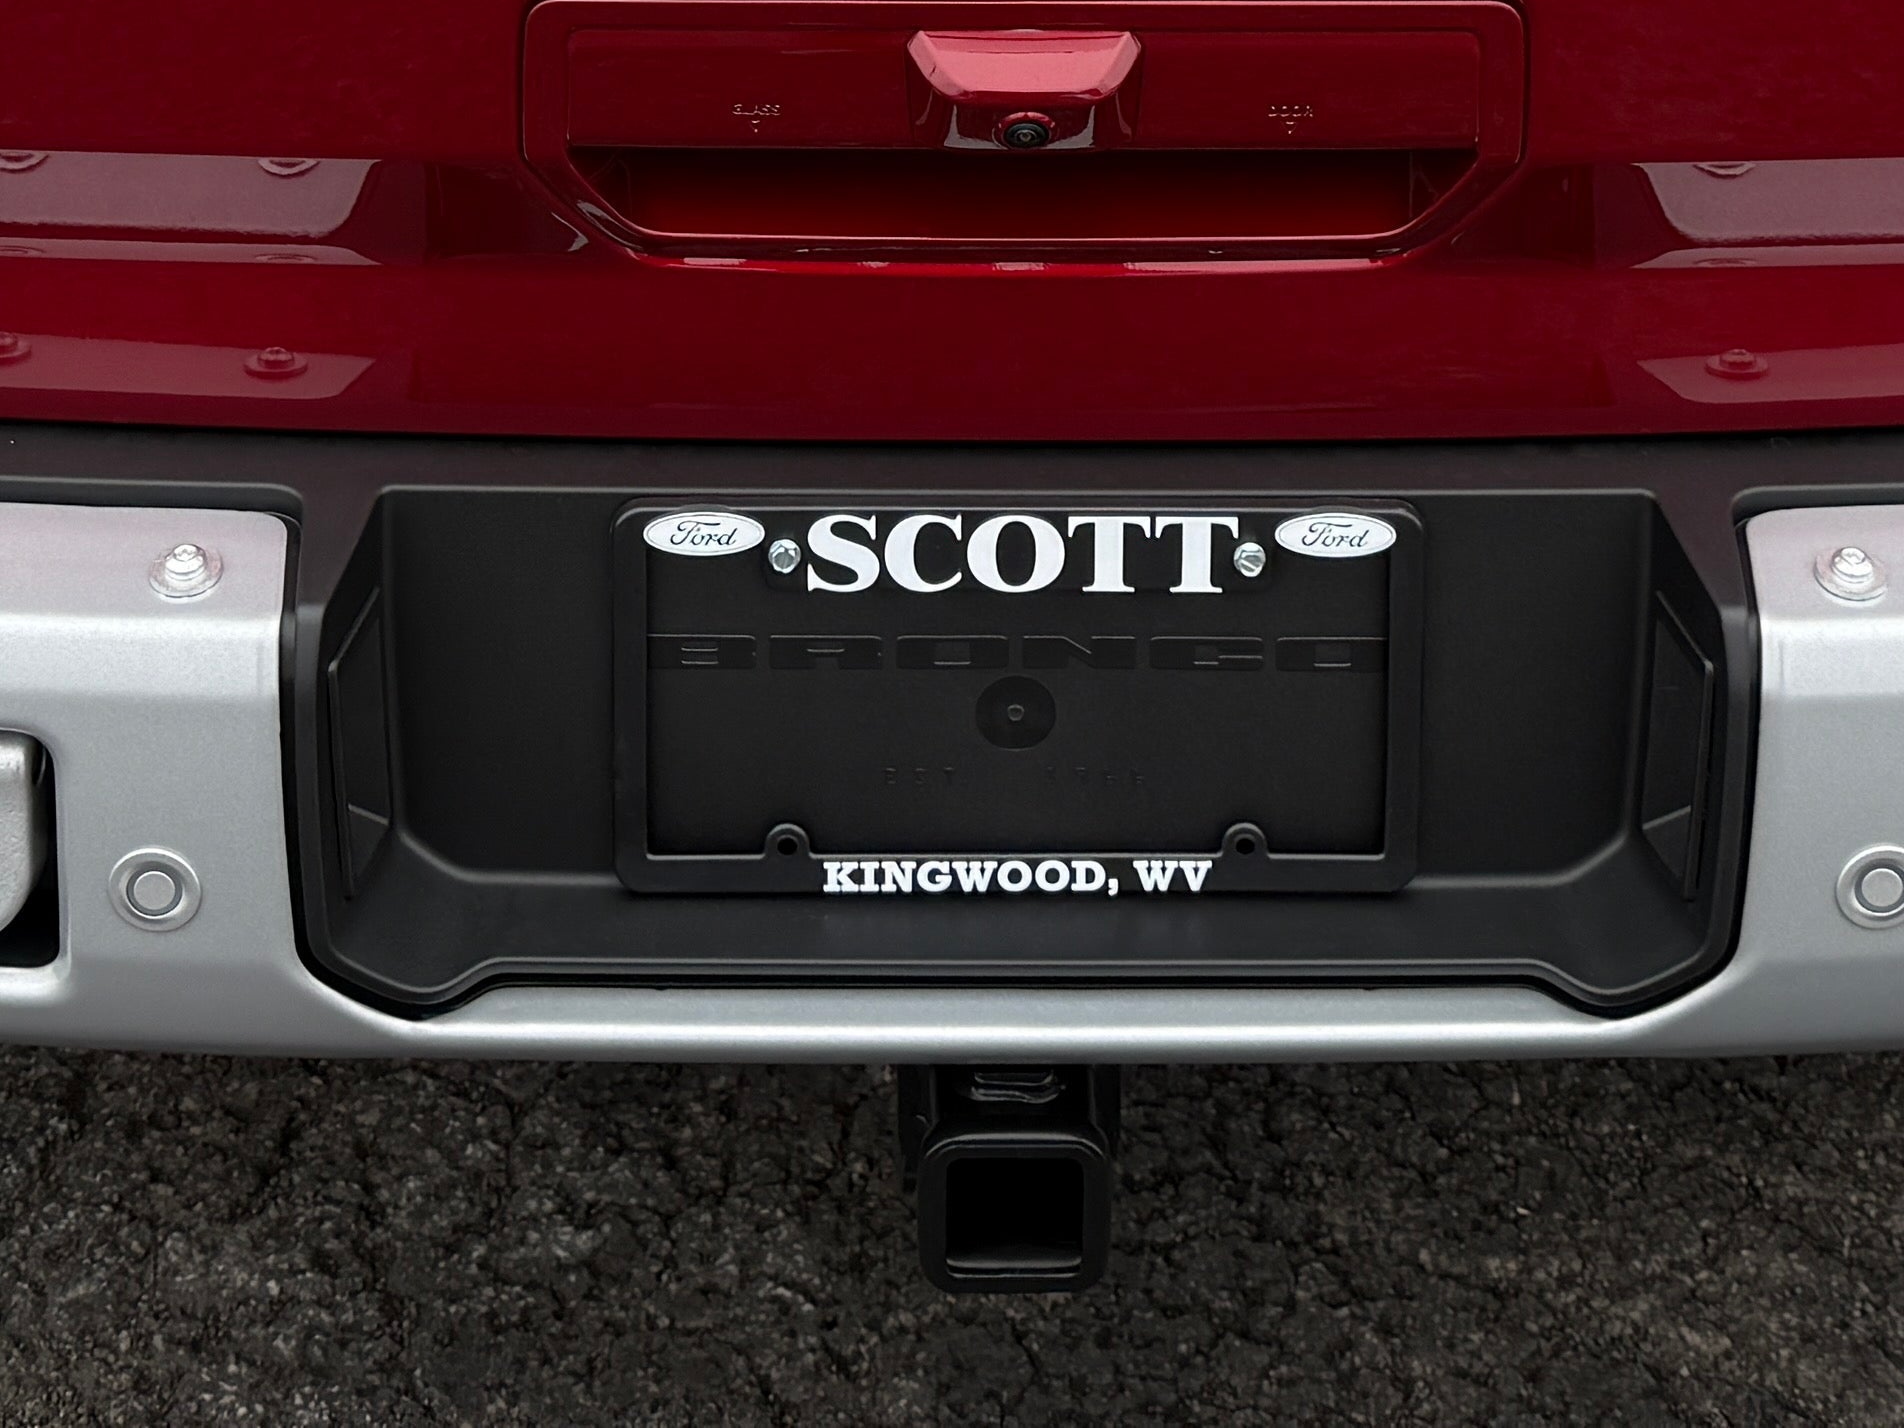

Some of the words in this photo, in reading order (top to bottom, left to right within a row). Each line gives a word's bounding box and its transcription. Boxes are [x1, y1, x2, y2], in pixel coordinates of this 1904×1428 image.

[668, 520, 738, 548] Ford
[1302, 521, 1372, 550] Ford
[806, 513, 1240, 594] SCOTT
[646, 633, 1388, 672] BRONCO
[823, 859, 1118, 895] KINGWOOD,
[1133, 860, 1212, 891] WV
